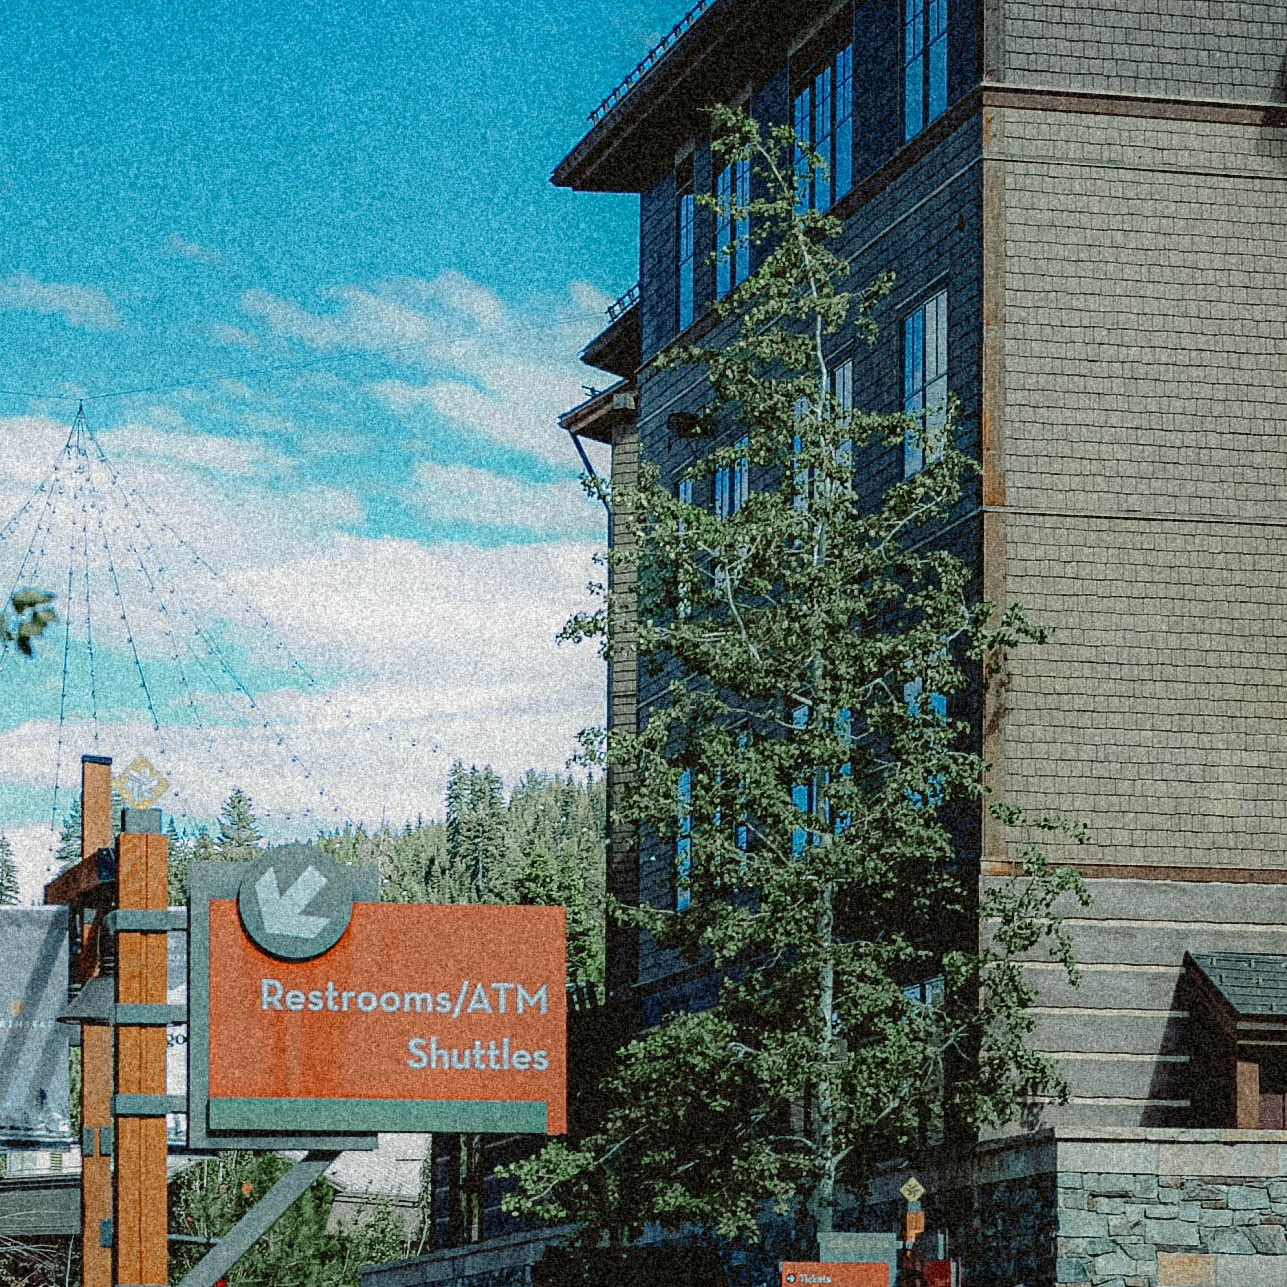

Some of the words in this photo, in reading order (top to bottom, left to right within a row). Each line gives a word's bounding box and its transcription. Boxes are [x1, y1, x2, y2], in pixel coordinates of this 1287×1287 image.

[260, 978, 548, 1018] Restrooms/ATM
[406, 1036, 550, 1071] Shuttles
[799, 1273, 832, 1284] Tickets
